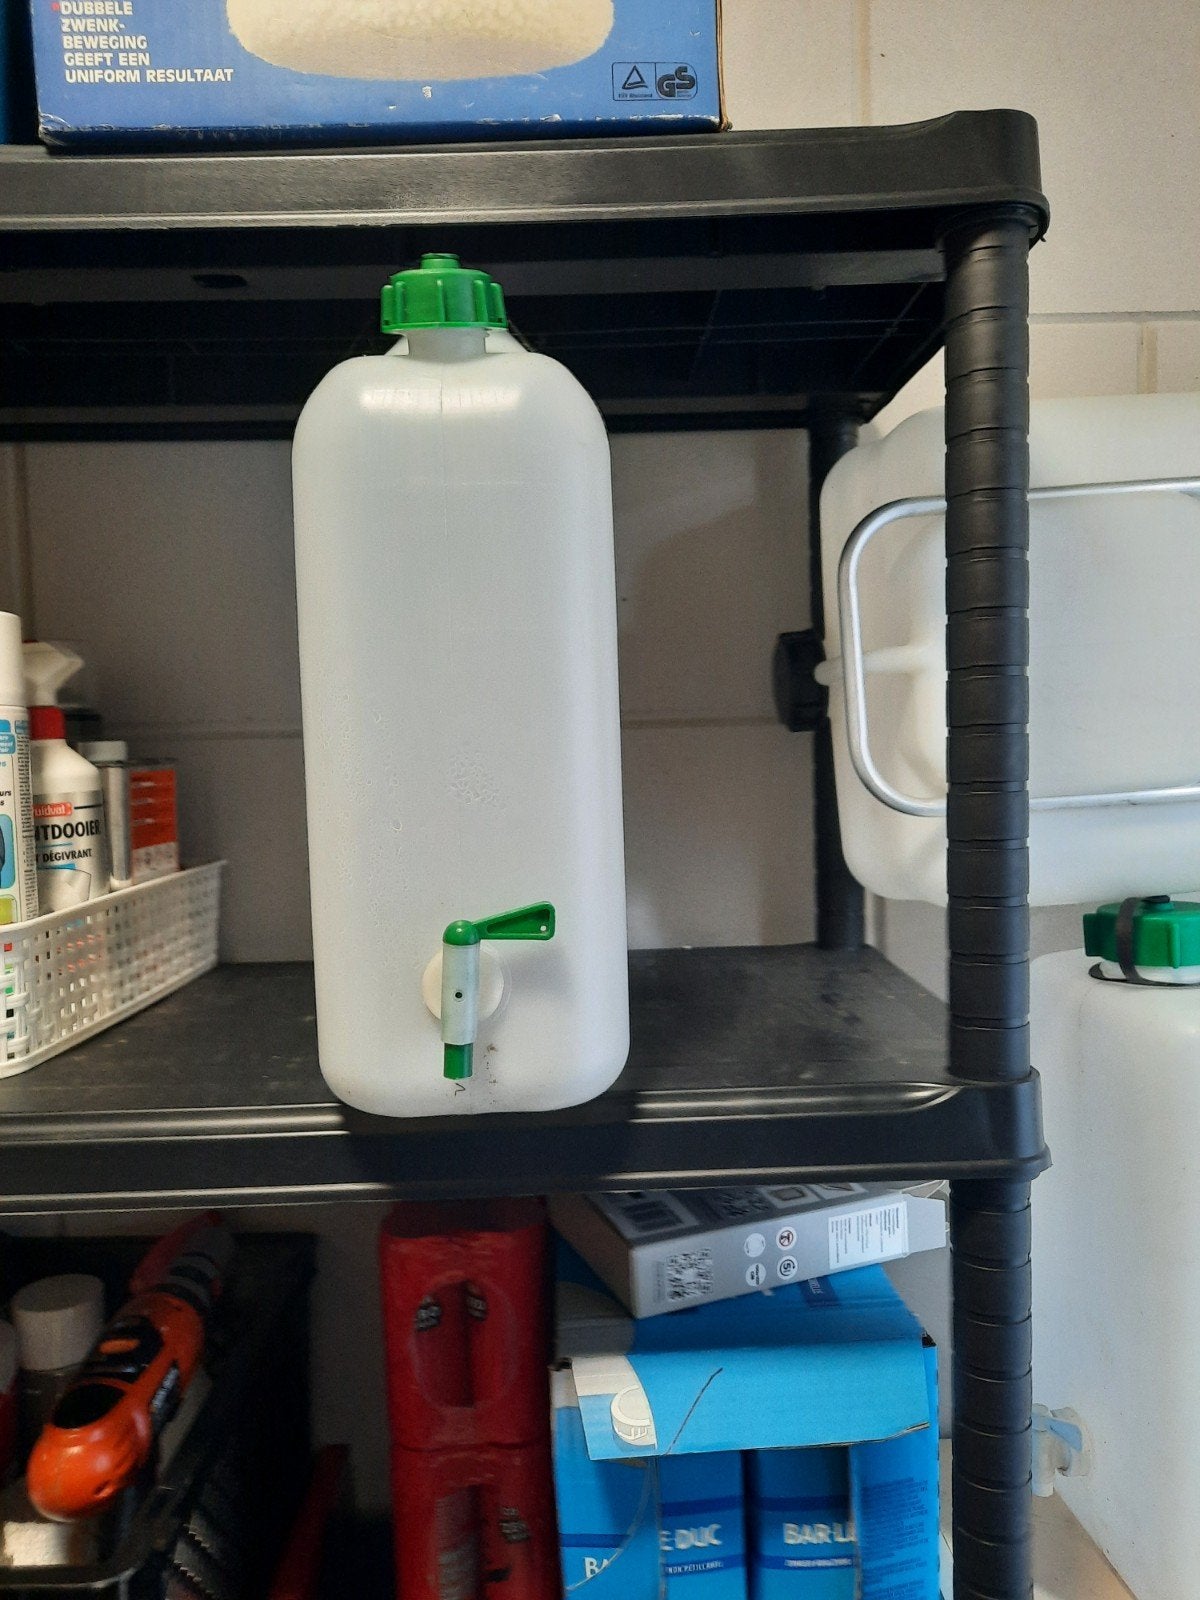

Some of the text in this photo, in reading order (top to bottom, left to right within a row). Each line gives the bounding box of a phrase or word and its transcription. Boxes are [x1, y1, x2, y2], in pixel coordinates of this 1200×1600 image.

[61, 1, 133, 15] DUBBELE
[61, 18, 125, 32] ZWENK-
[63, 35, 148, 50] BEWEGING
[64, 52, 150, 66] GEEFT EEN
[65, 68, 234, 83] UNIFORM RESULTAAT
